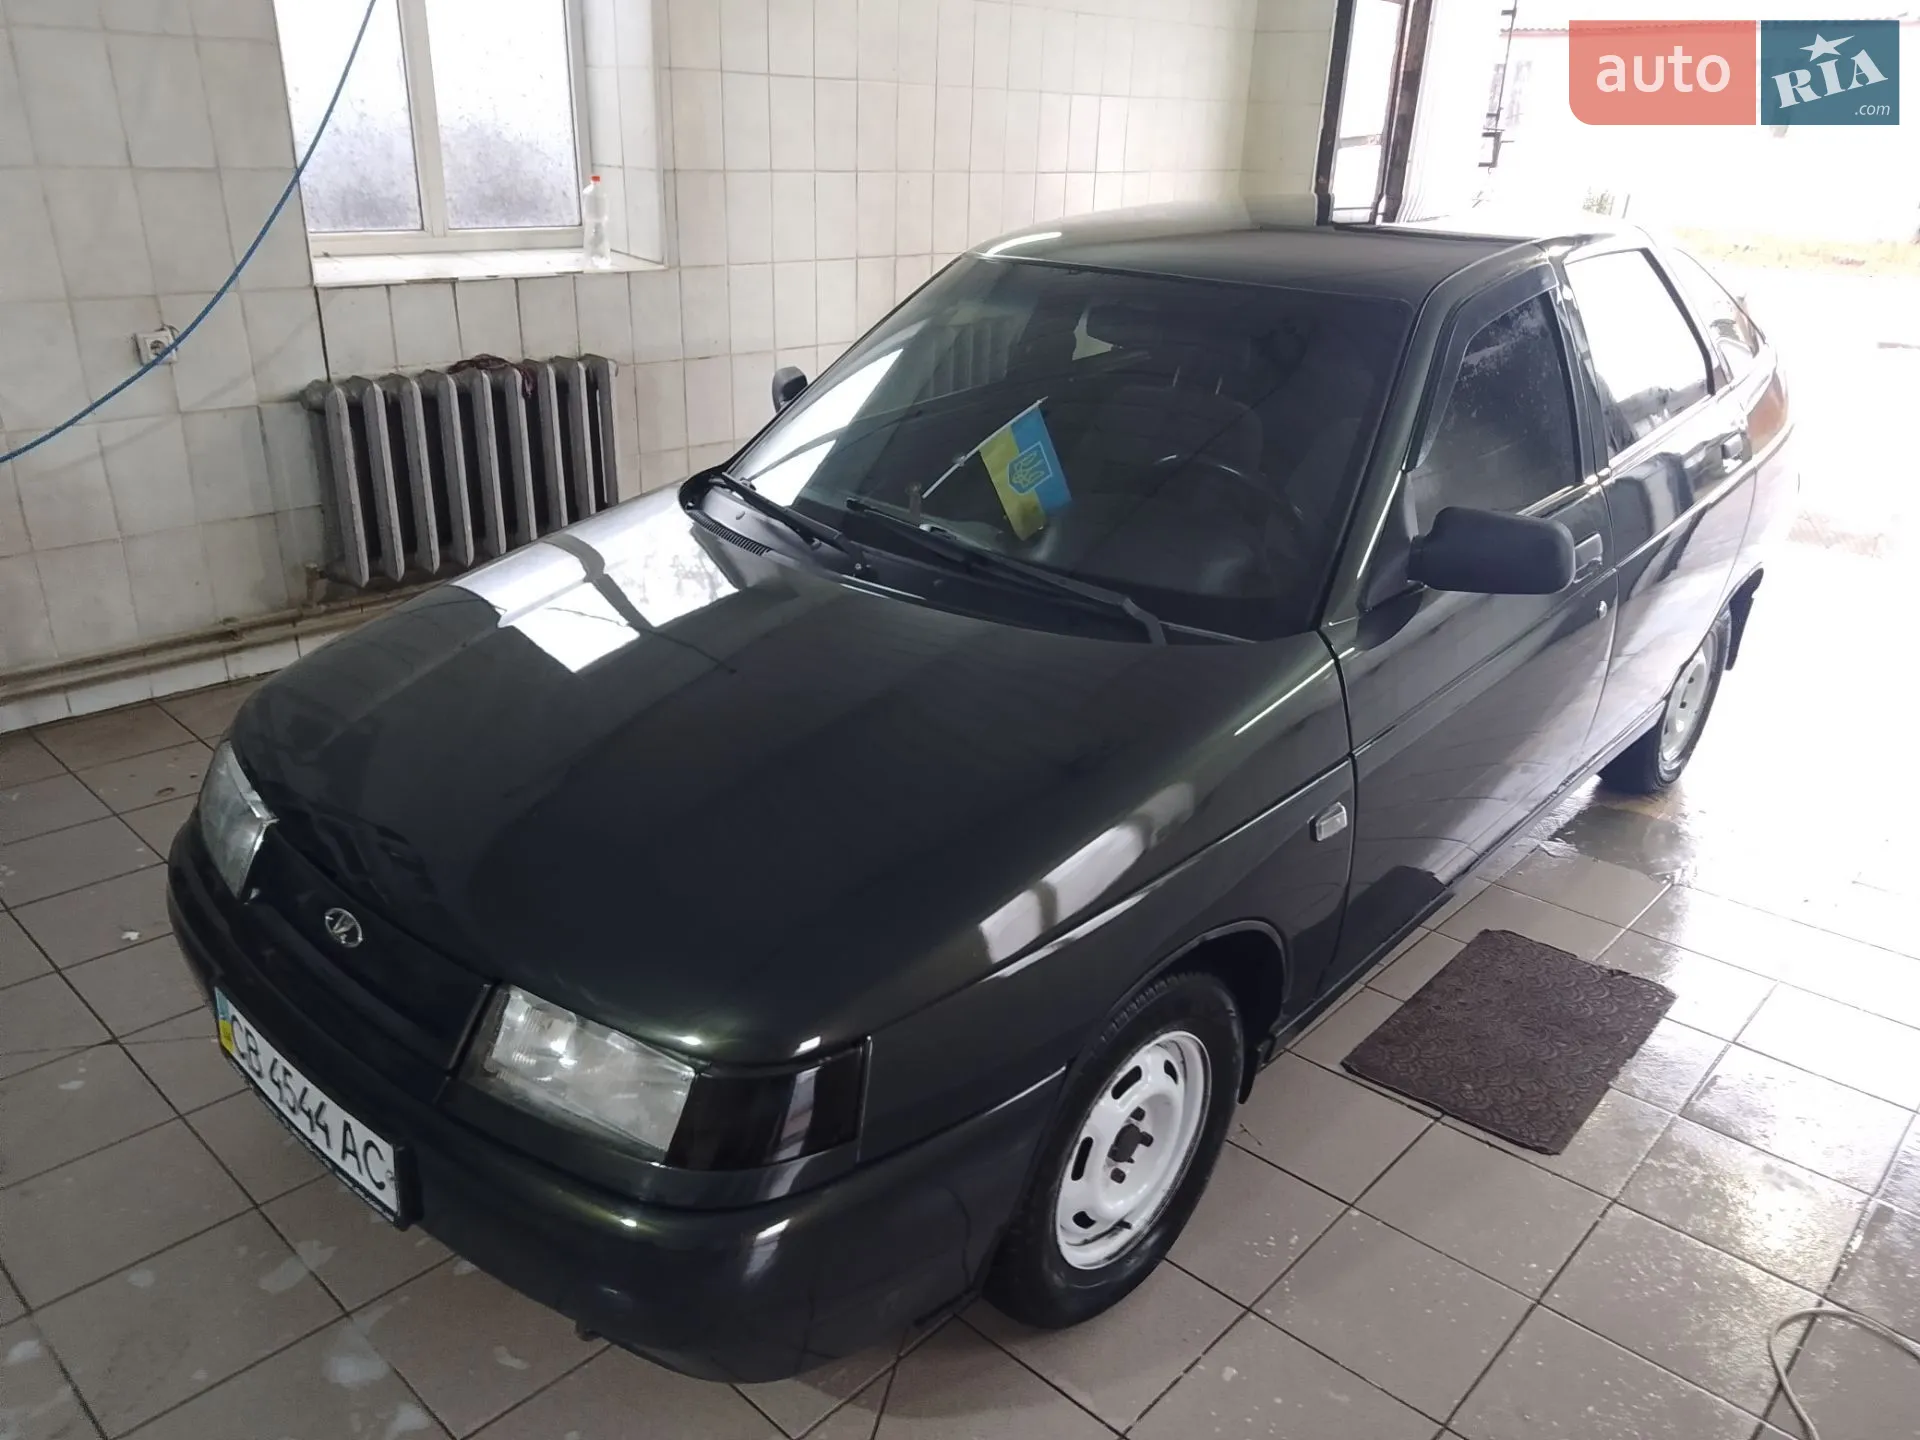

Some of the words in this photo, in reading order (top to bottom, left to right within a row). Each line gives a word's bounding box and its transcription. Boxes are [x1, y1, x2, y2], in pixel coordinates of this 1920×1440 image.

[230, 1014, 264, 1079] CB
[269, 1057, 332, 1150] 4544
[341, 1119, 386, 1191] AC
